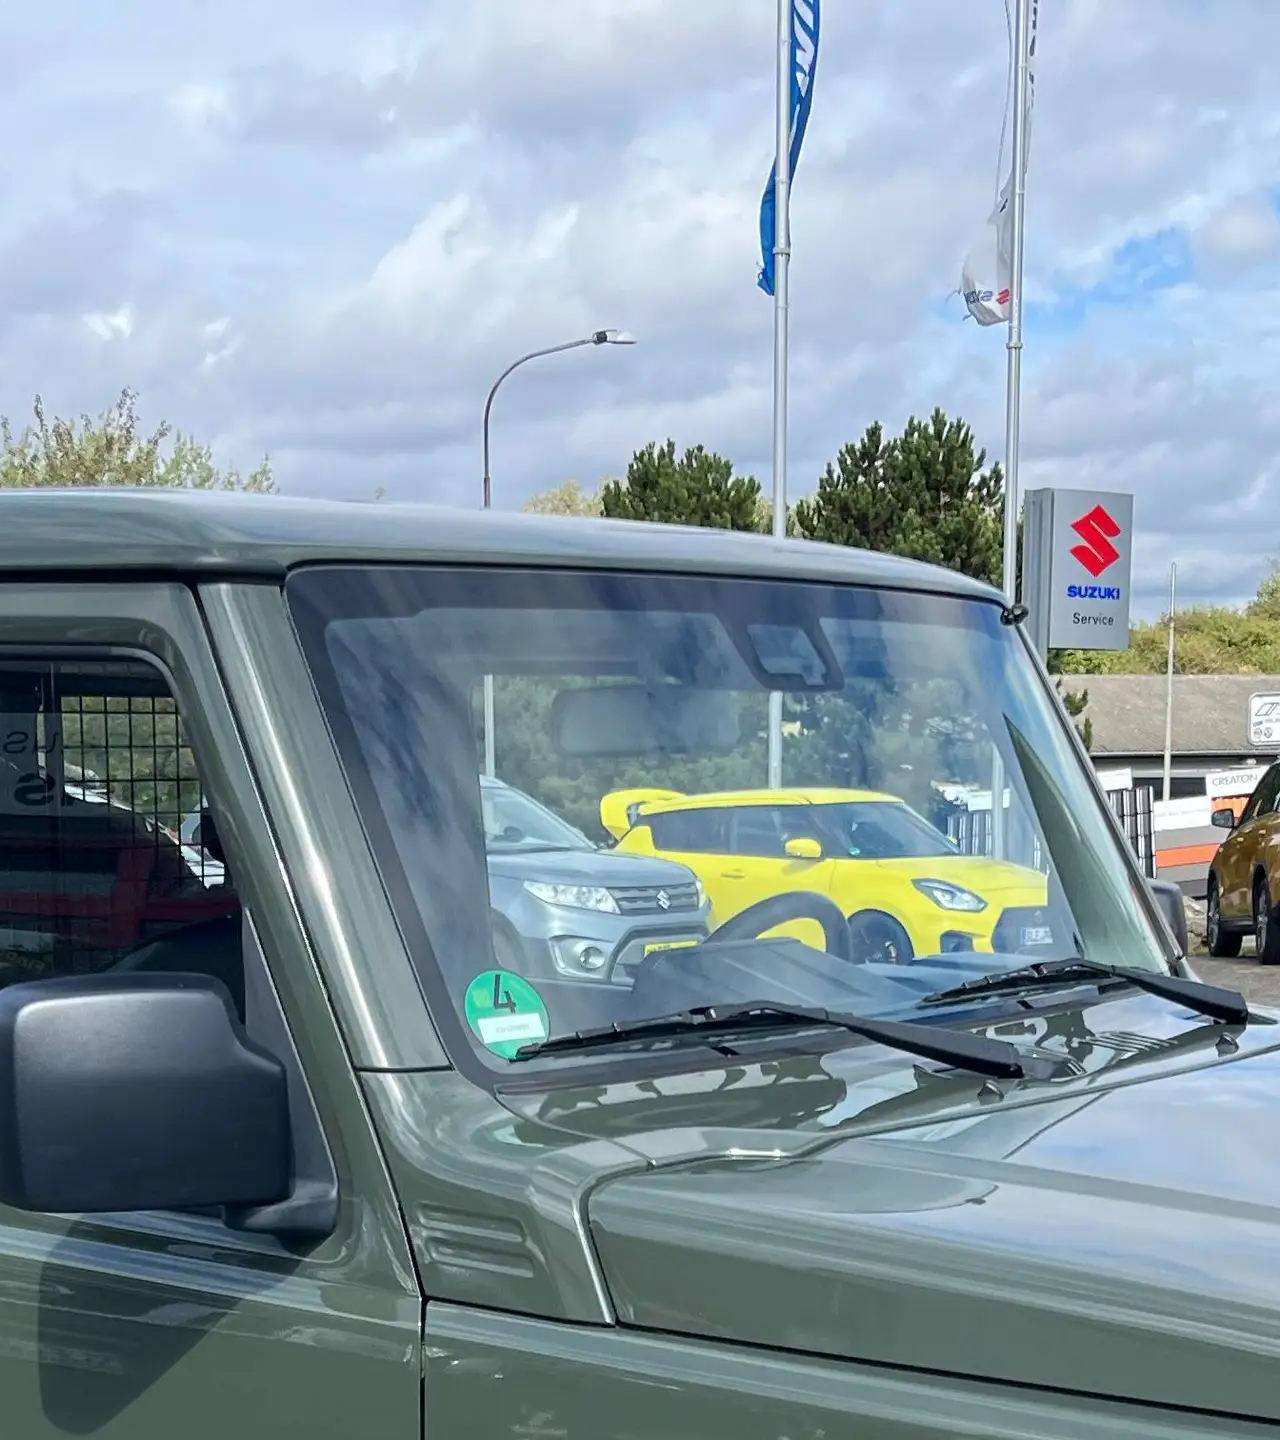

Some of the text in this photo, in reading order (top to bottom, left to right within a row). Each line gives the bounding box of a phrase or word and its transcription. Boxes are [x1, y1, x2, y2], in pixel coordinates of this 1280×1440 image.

[1067, 585, 1120, 600] SUZUKI
[1073, 612, 1114, 626] Service
[1212, 774, 1258, 787] CREATON
[494, 974, 516, 1014] 4
